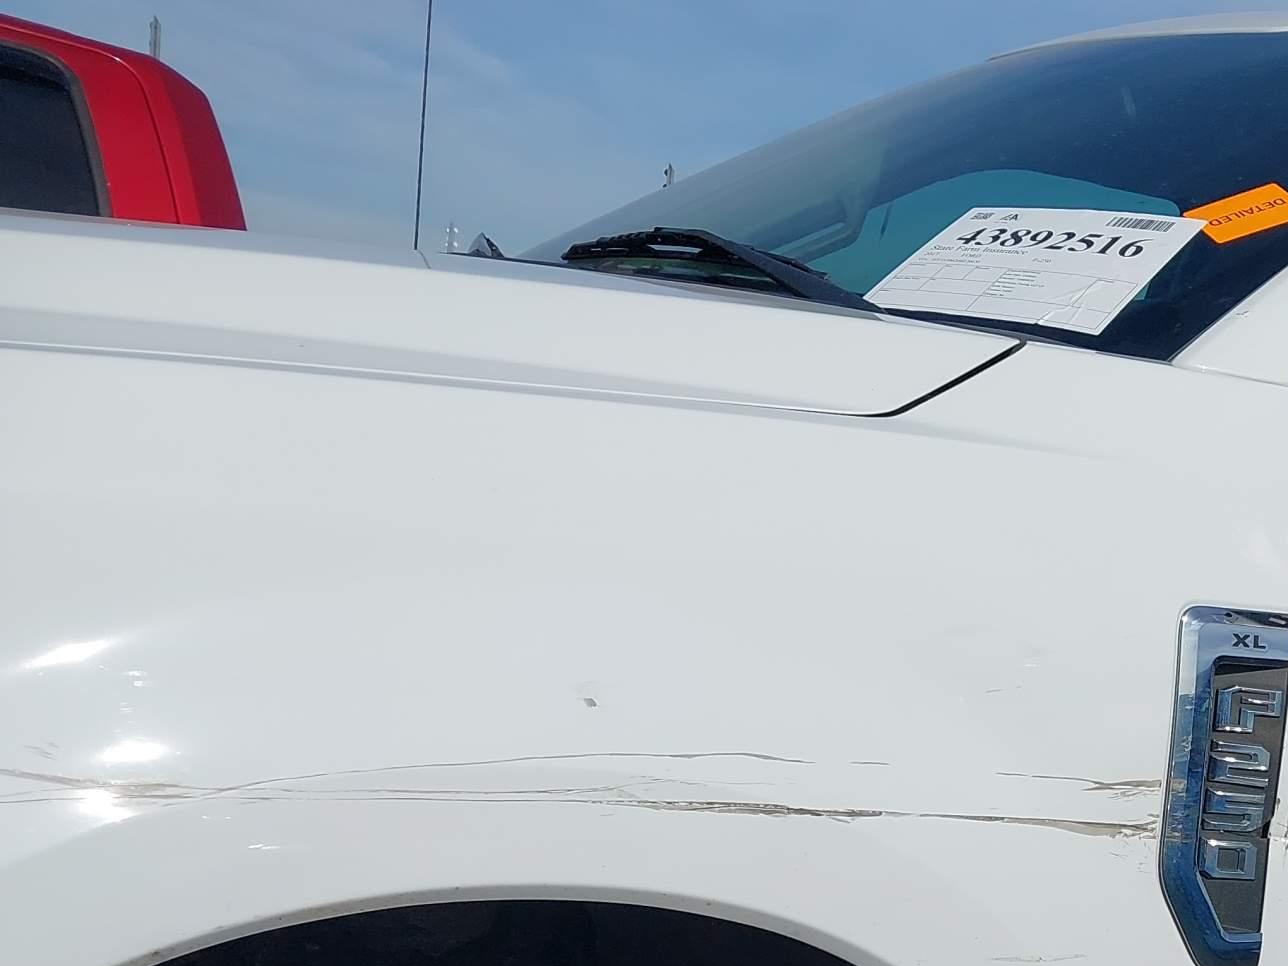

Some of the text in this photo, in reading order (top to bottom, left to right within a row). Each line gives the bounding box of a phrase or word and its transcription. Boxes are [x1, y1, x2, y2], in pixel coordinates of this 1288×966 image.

[1208, 198, 1287, 227] DETAILED
[956, 227, 1155, 258] 43892516
[982, 246, 1029, 255] Insurance
[1231, 633, 1267, 650] XL
